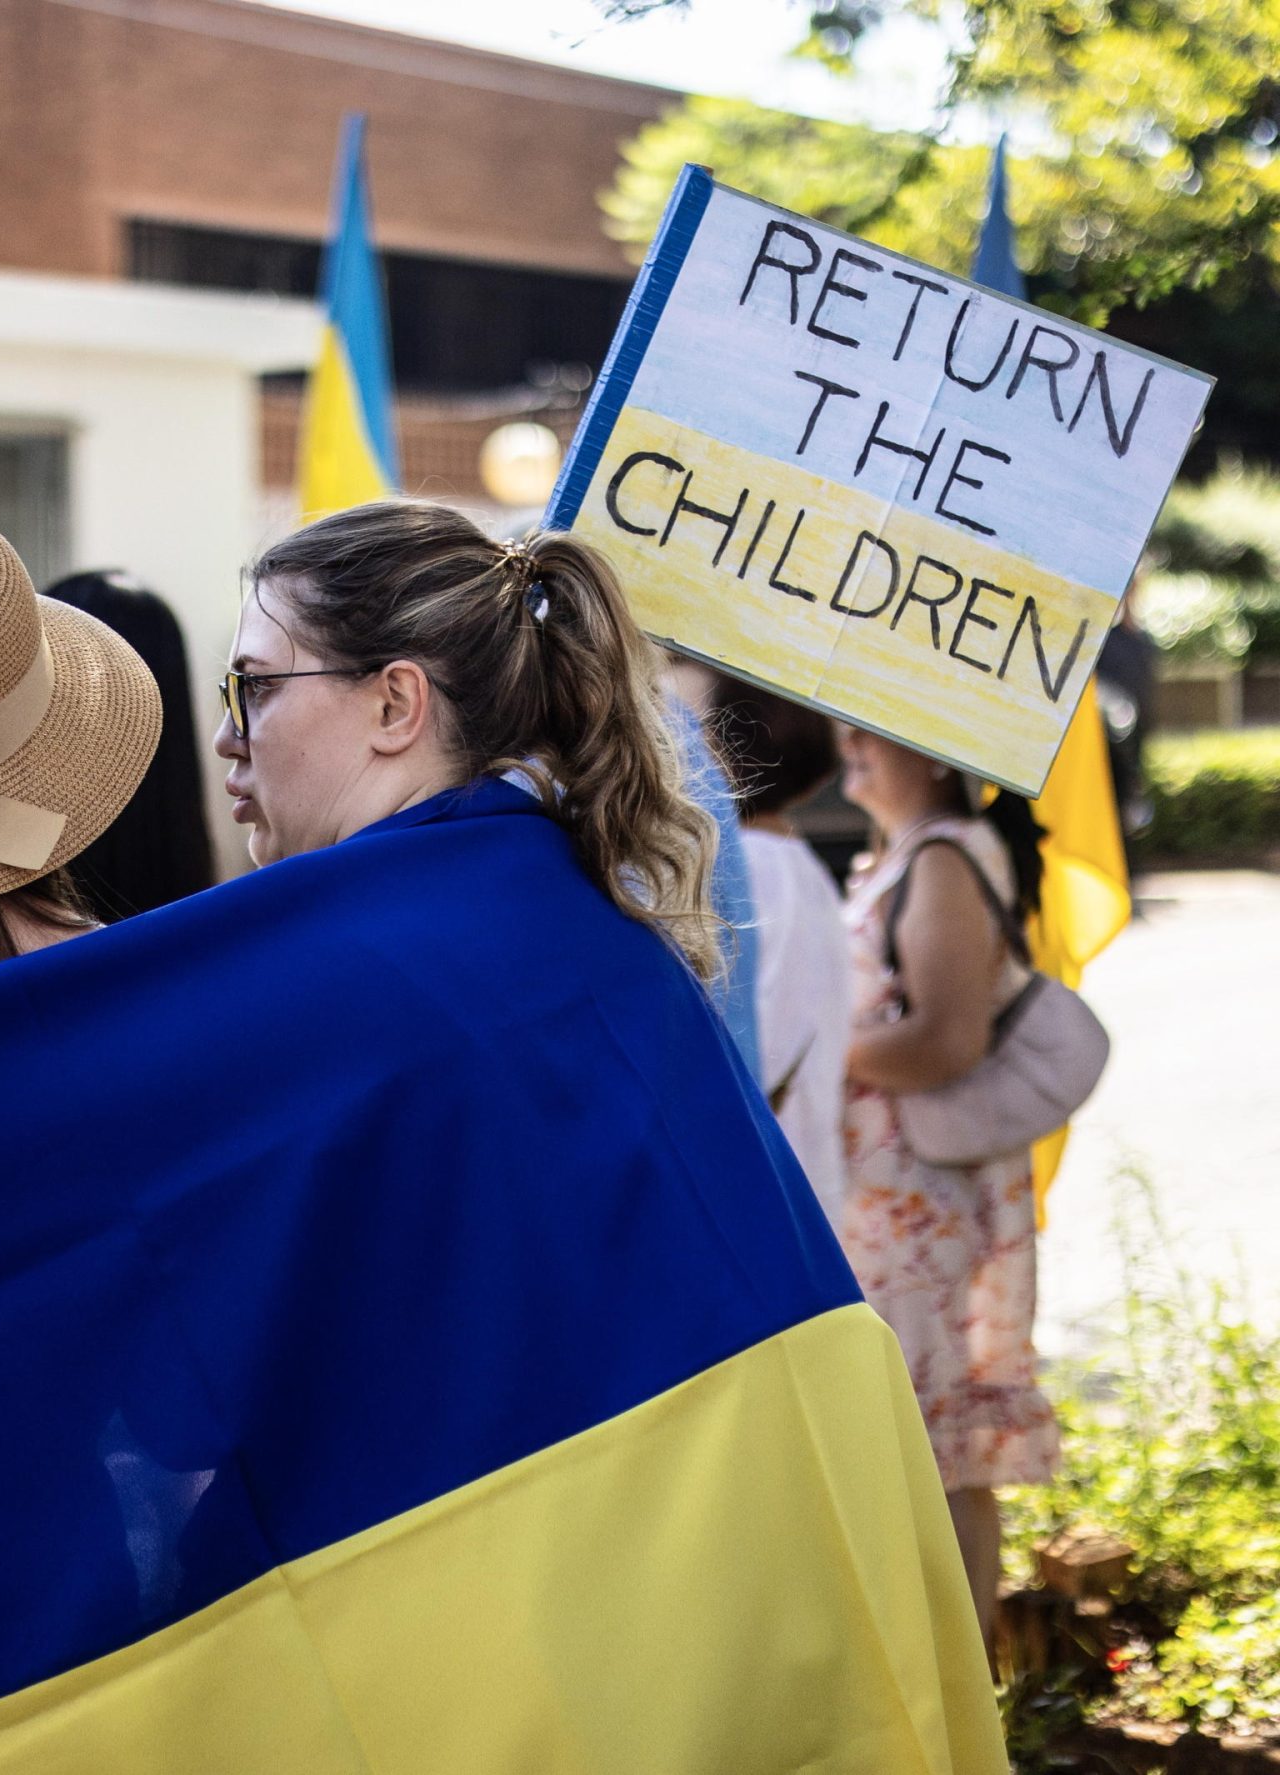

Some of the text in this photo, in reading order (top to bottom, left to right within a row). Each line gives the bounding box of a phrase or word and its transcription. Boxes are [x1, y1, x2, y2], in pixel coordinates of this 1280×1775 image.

[739, 220, 1154, 458] RETURN
[794, 370, 1012, 536] THE
[606, 451, 1089, 701] CHILDREN
